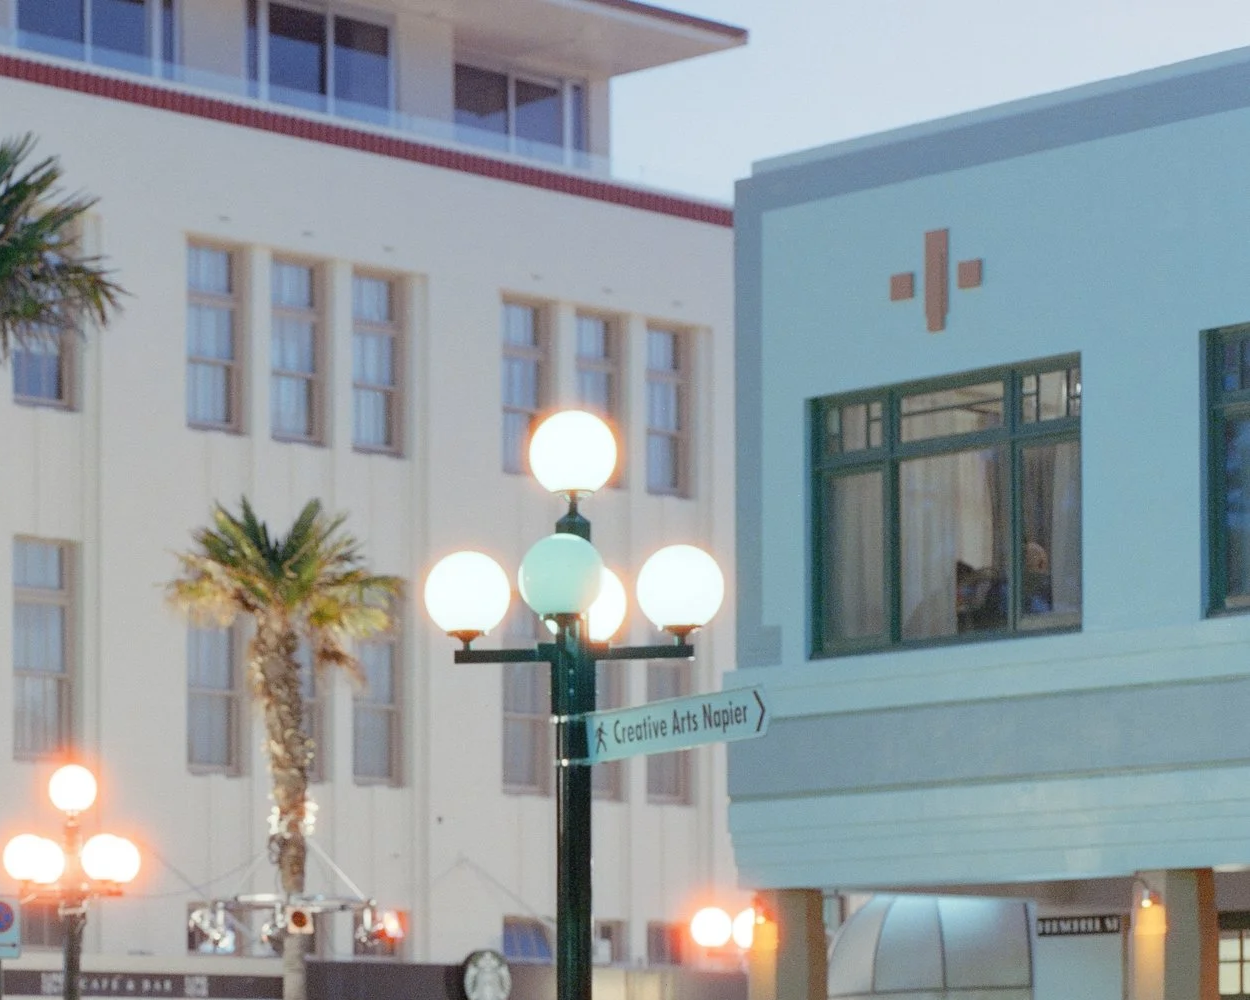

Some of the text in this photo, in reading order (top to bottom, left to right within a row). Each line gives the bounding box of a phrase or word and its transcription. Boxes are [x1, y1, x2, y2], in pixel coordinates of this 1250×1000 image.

[613, 700, 748, 745] Creative Arts Napier
